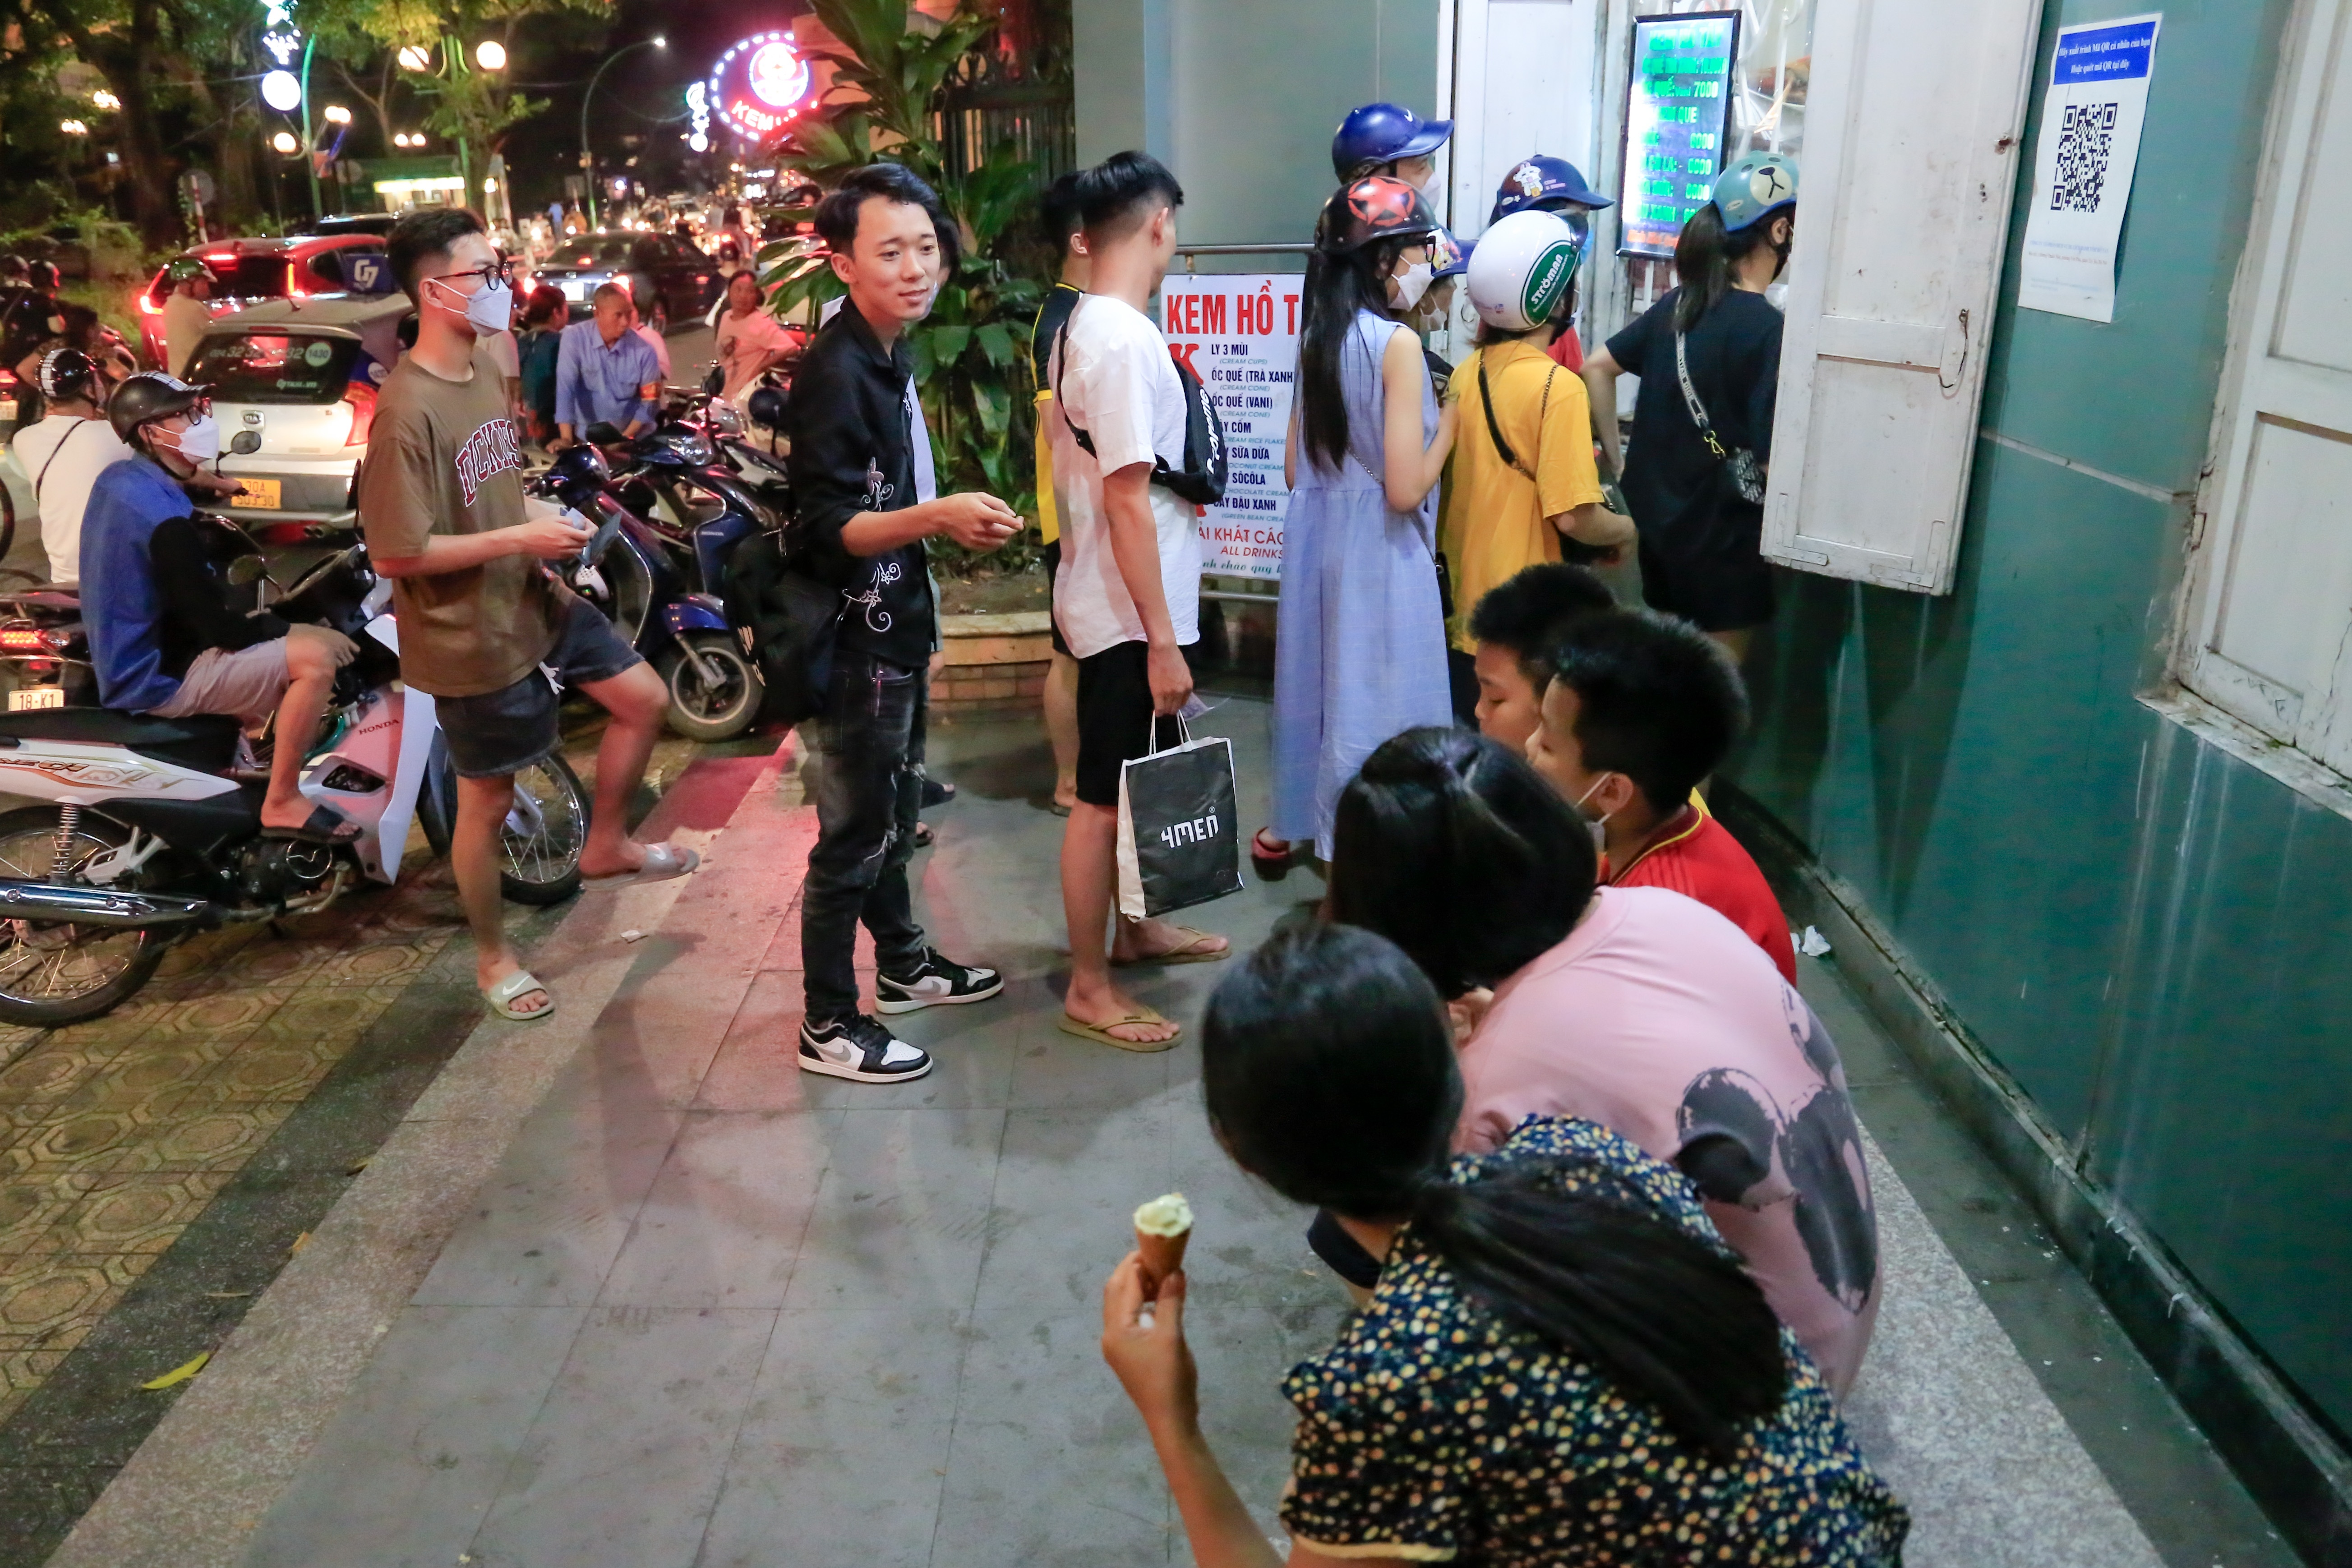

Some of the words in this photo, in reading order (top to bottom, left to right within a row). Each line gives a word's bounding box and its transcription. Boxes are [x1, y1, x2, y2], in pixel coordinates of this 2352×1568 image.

[2101, 42, 2110, 53] QR
[2103, 61, 2112, 71] QR
[1694, 81, 1718, 98] 7000
[731, 100, 774, 131] KEM
[1167, 295, 1226, 334] KEM
[1237, 280, 1273, 335] HỒ
[1212, 344, 1220, 355] LY
[1223, 344, 1228, 355] 3
[1231, 342, 1248, 355] MÙI
[1212, 366, 1223, 381] ỐC
[1226, 367, 1243, 382] QUẾ
[1246, 369, 1265, 383] (TRÀ
[1212, 391, 1223, 406] ỐC
[1226, 393, 1243, 408] QUẾ
[1246, 397, 1273, 409] (VANI)
[1232, 418, 1251, 433] CỐM
[1232, 445, 1249, 458] SỮA
[1232, 470, 1266, 485] SÔCÔLA
[1232, 496, 1250, 511] ĐẬU
[1253, 499, 1276, 511] XANH
[1199, 521, 1209, 540] ẢI
[1214, 525, 1250, 543] KHÁT
[1220, 545, 1239, 555] ALL
[1243, 547, 1282, 559] DRINKS
[19, 694, 54, 710] 18-K1
[359, 719, 400, 735] HONDA
